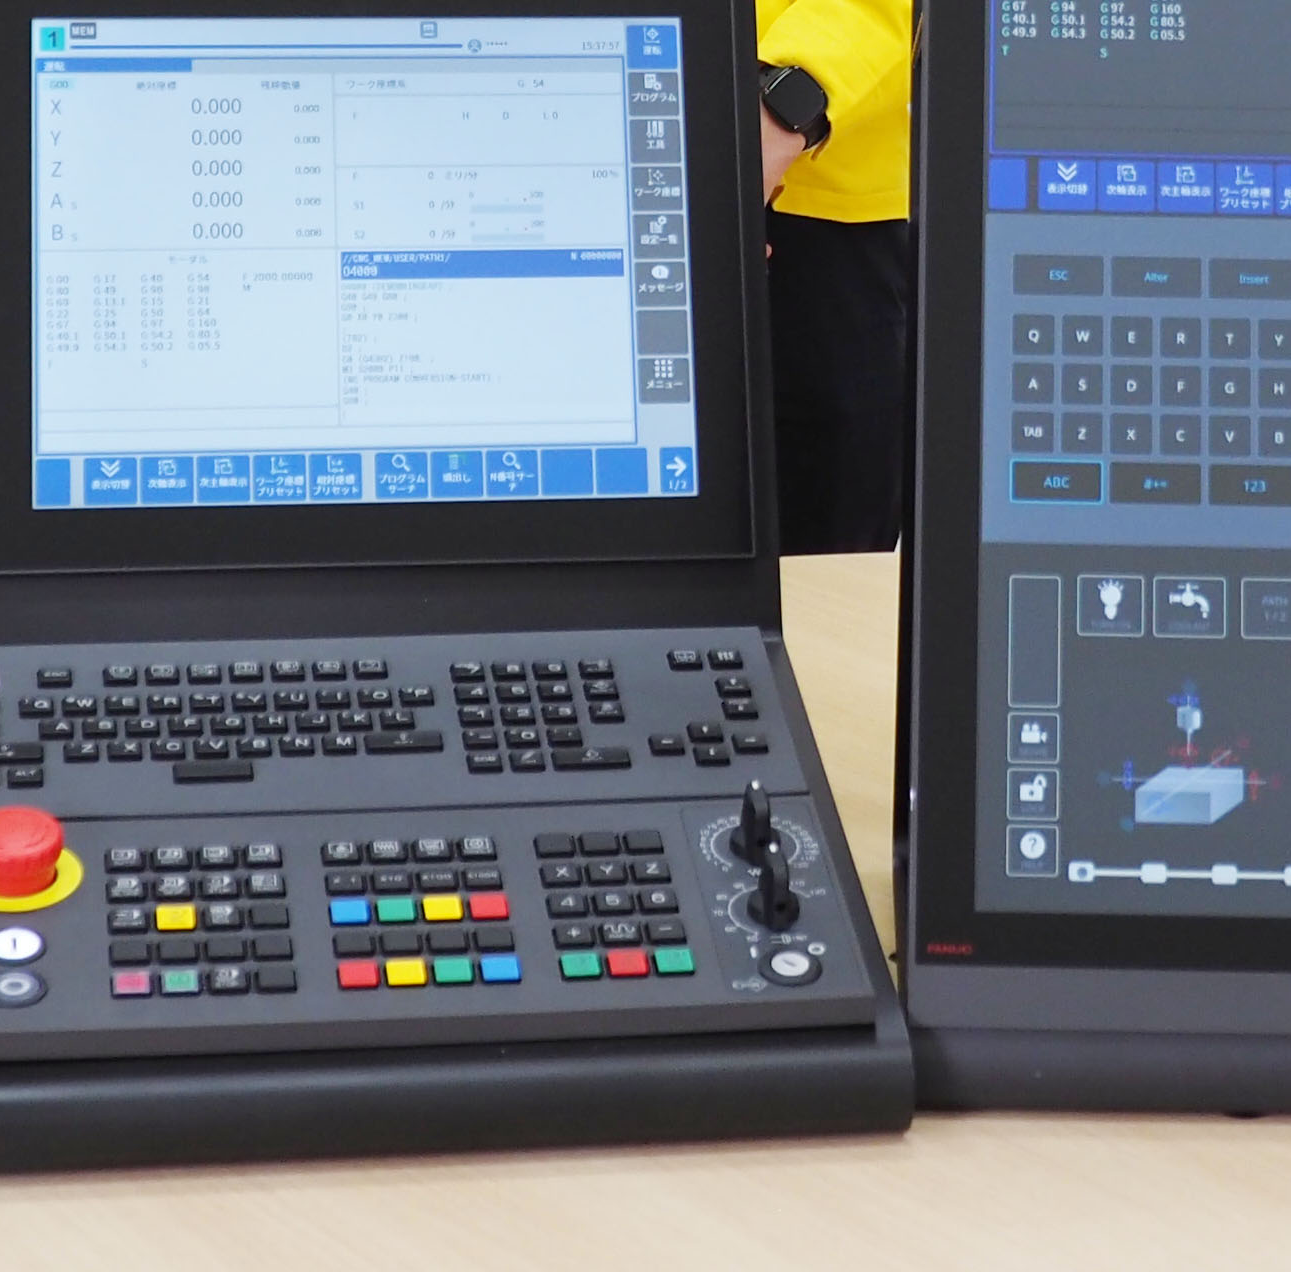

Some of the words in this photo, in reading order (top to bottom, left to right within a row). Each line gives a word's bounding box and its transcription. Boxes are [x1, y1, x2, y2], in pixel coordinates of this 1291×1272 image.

[71, 25, 96, 38] MEM
[48, 31, 58, 47] 1
[631, 92, 677, 102] プログラム
[51, 100, 61, 115] X
[191, 98, 241, 114] 0.000
[50, 131, 61, 146] Y
[192, 129, 242, 145] 0.000
[51, 162, 61, 177] Z
[192, 160, 242, 176] 0.000
[51, 193, 62, 208] A
[192, 192, 243, 208] 0.000
[52, 225, 63, 240] B
[193, 223, 243, 239] 0.000
[1050, 270, 1068, 280] ESC
[1239, 274, 1269, 284] Insert
[639, 281, 684, 293] メッセージ
[1028, 330, 1039, 343] Q
[1076, 331, 1090, 342] W
[1128, 331, 1135, 343] E
[1177, 332, 1185, 344] R
[1226, 333, 1233, 345] T
[1275, 335, 1283, 346] Y
[646, 379, 683, 389] メニュー
[1028, 378, 1038, 389] A
[1078, 379, 1087, 391] S
[1127, 380, 1137, 392] D
[1177, 381, 1184, 393] F
[1225, 382, 1235, 394] G
[1274, 383, 1284, 394] H
[1024, 427, 1043, 437] TAB
[1078, 428, 1086, 440] Z
[1127, 429, 1135, 440] X
[1176, 430, 1185, 442] C
[1225, 431, 1234, 442] V
[1275, 432, 1284, 444] B
[380, 473, 426, 485] プログラム
[1044, 477, 1069, 488] ABC
[668, 480, 688, 491] 1/2
[1245, 480, 1266, 492] 123
[556, 867, 569, 877] X
[600, 865, 613, 874] Y
[647, 863, 658, 874] Z
[561, 896, 575, 907] 4
